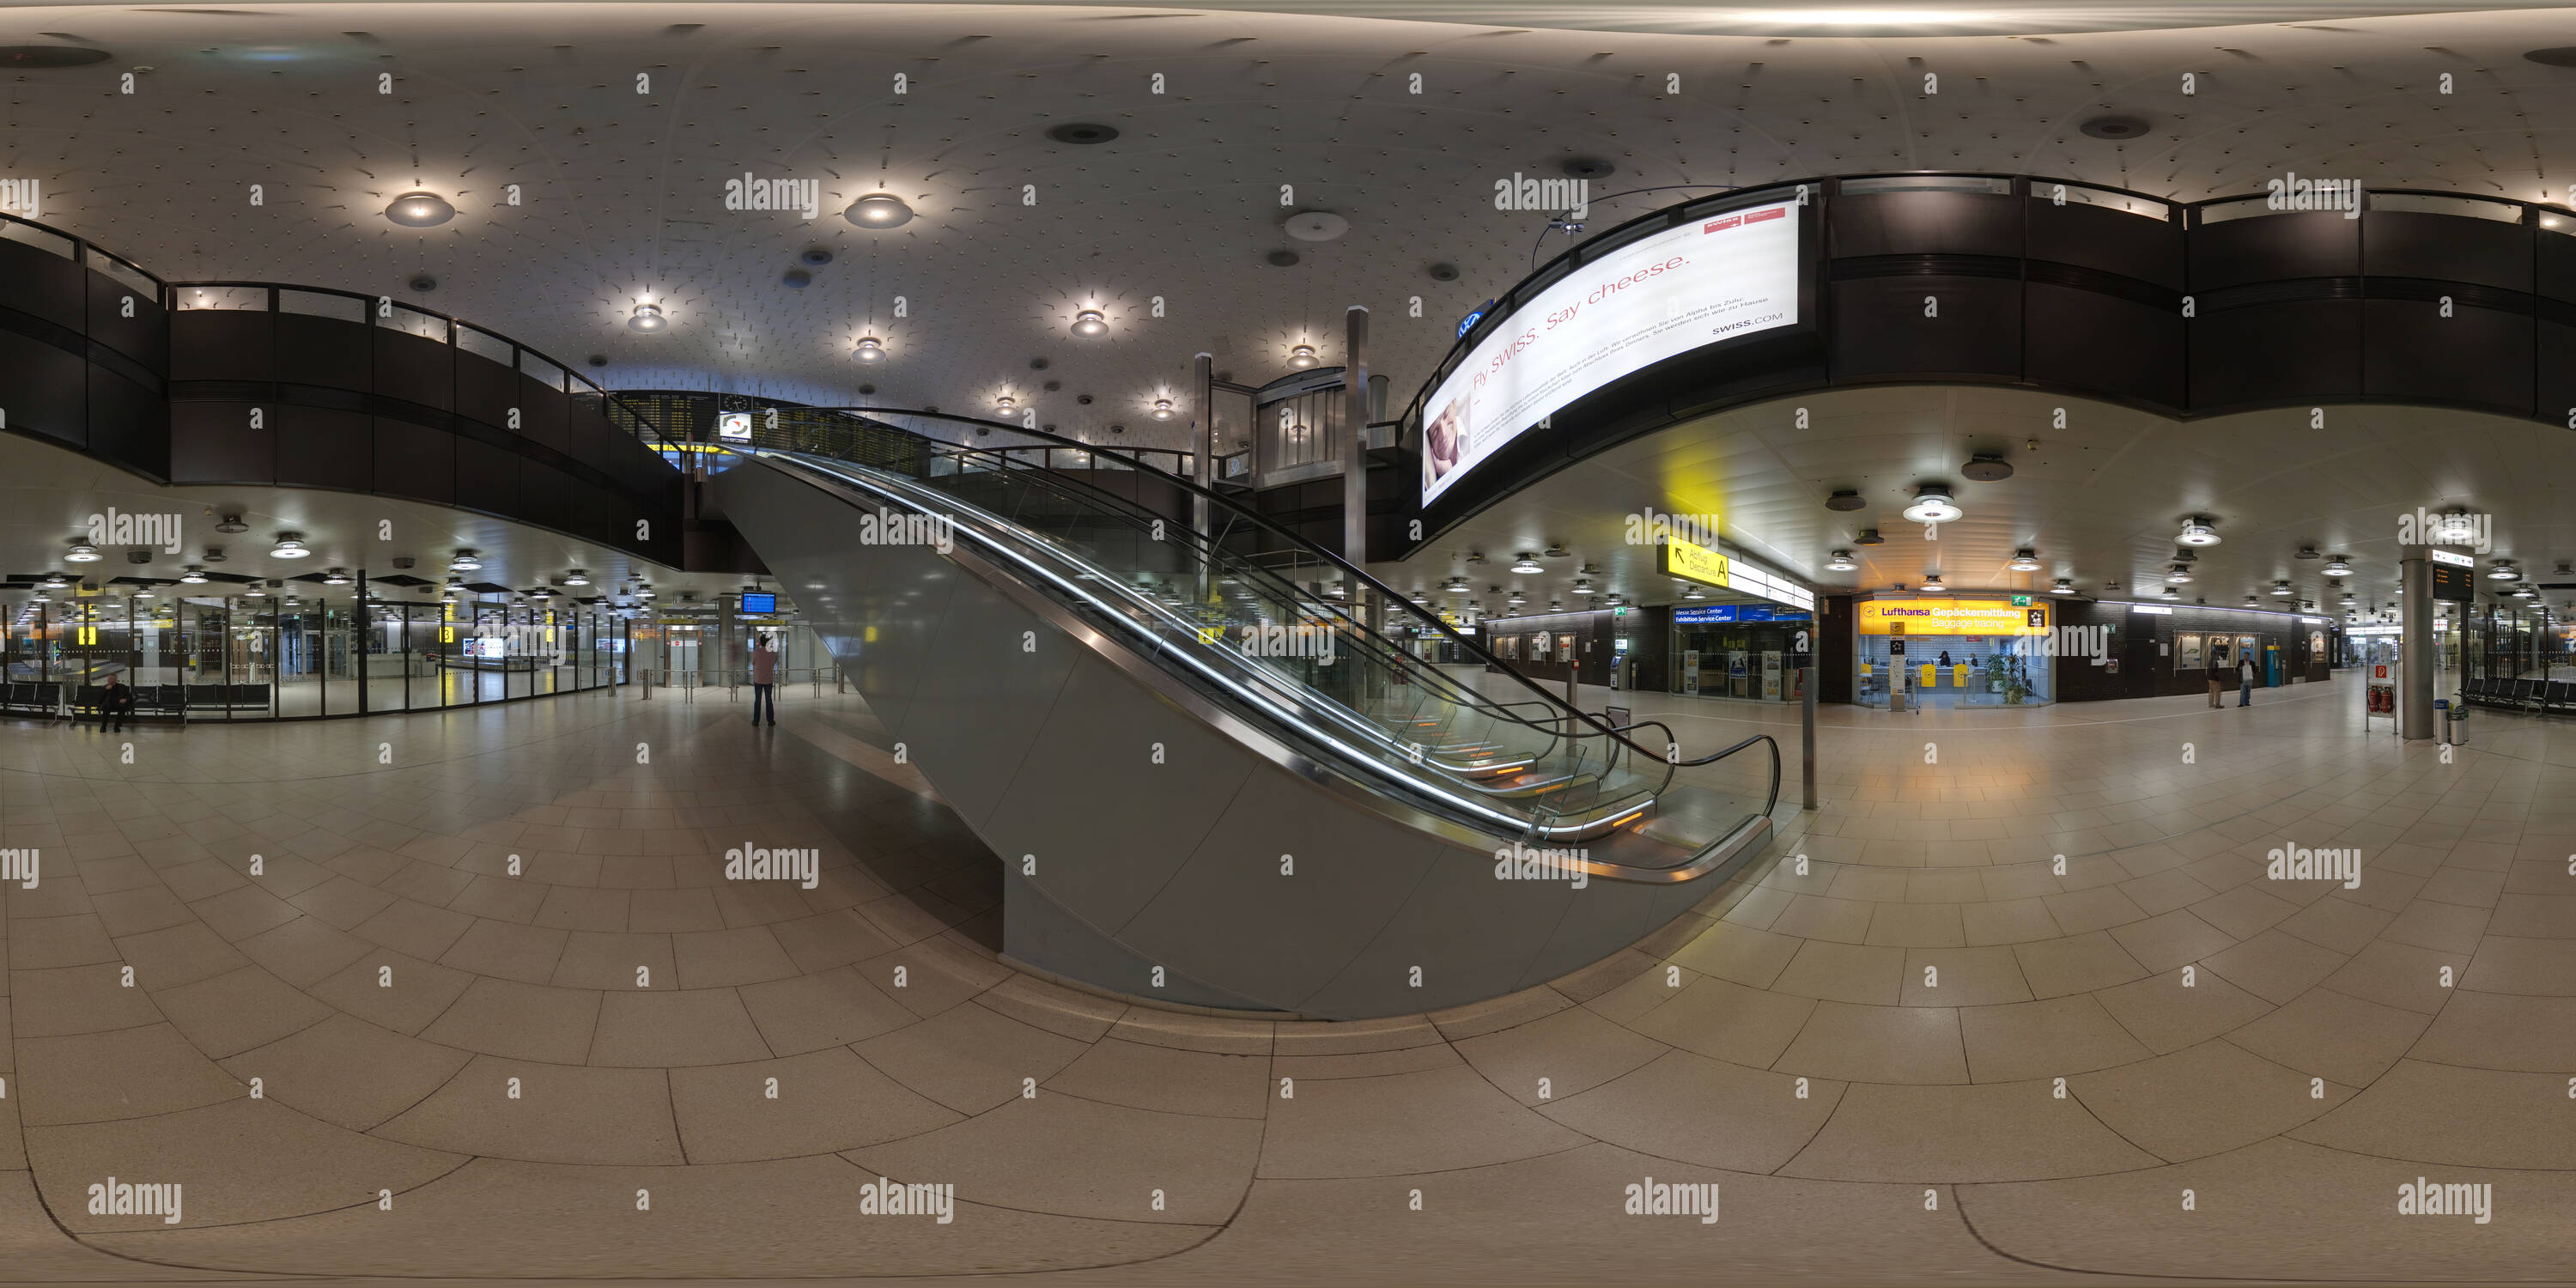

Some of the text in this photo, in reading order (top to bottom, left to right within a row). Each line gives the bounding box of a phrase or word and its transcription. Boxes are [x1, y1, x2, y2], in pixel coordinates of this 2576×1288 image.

[1665, 318, 1692, 331] werden
[1694, 312, 1710, 320] sich
[1741, 297, 1769, 307] Hause
[1686, 307, 1708, 317] Alpha
[1710, 301, 1722, 310] bis
[1473, 256, 1691, 392] Fly SWISS. Say cheese.
[1712, 312, 1783, 335] SWISS.COM
[1690, 549, 1708, 565] Abflug
[1689, 560, 1716, 577] Departure
[1717, 560, 1727, 580] A
[1881, 607, 2021, 619] Lufthansa Gepäckermittlung
[1932, 617, 2005, 629] Baggage tracing
